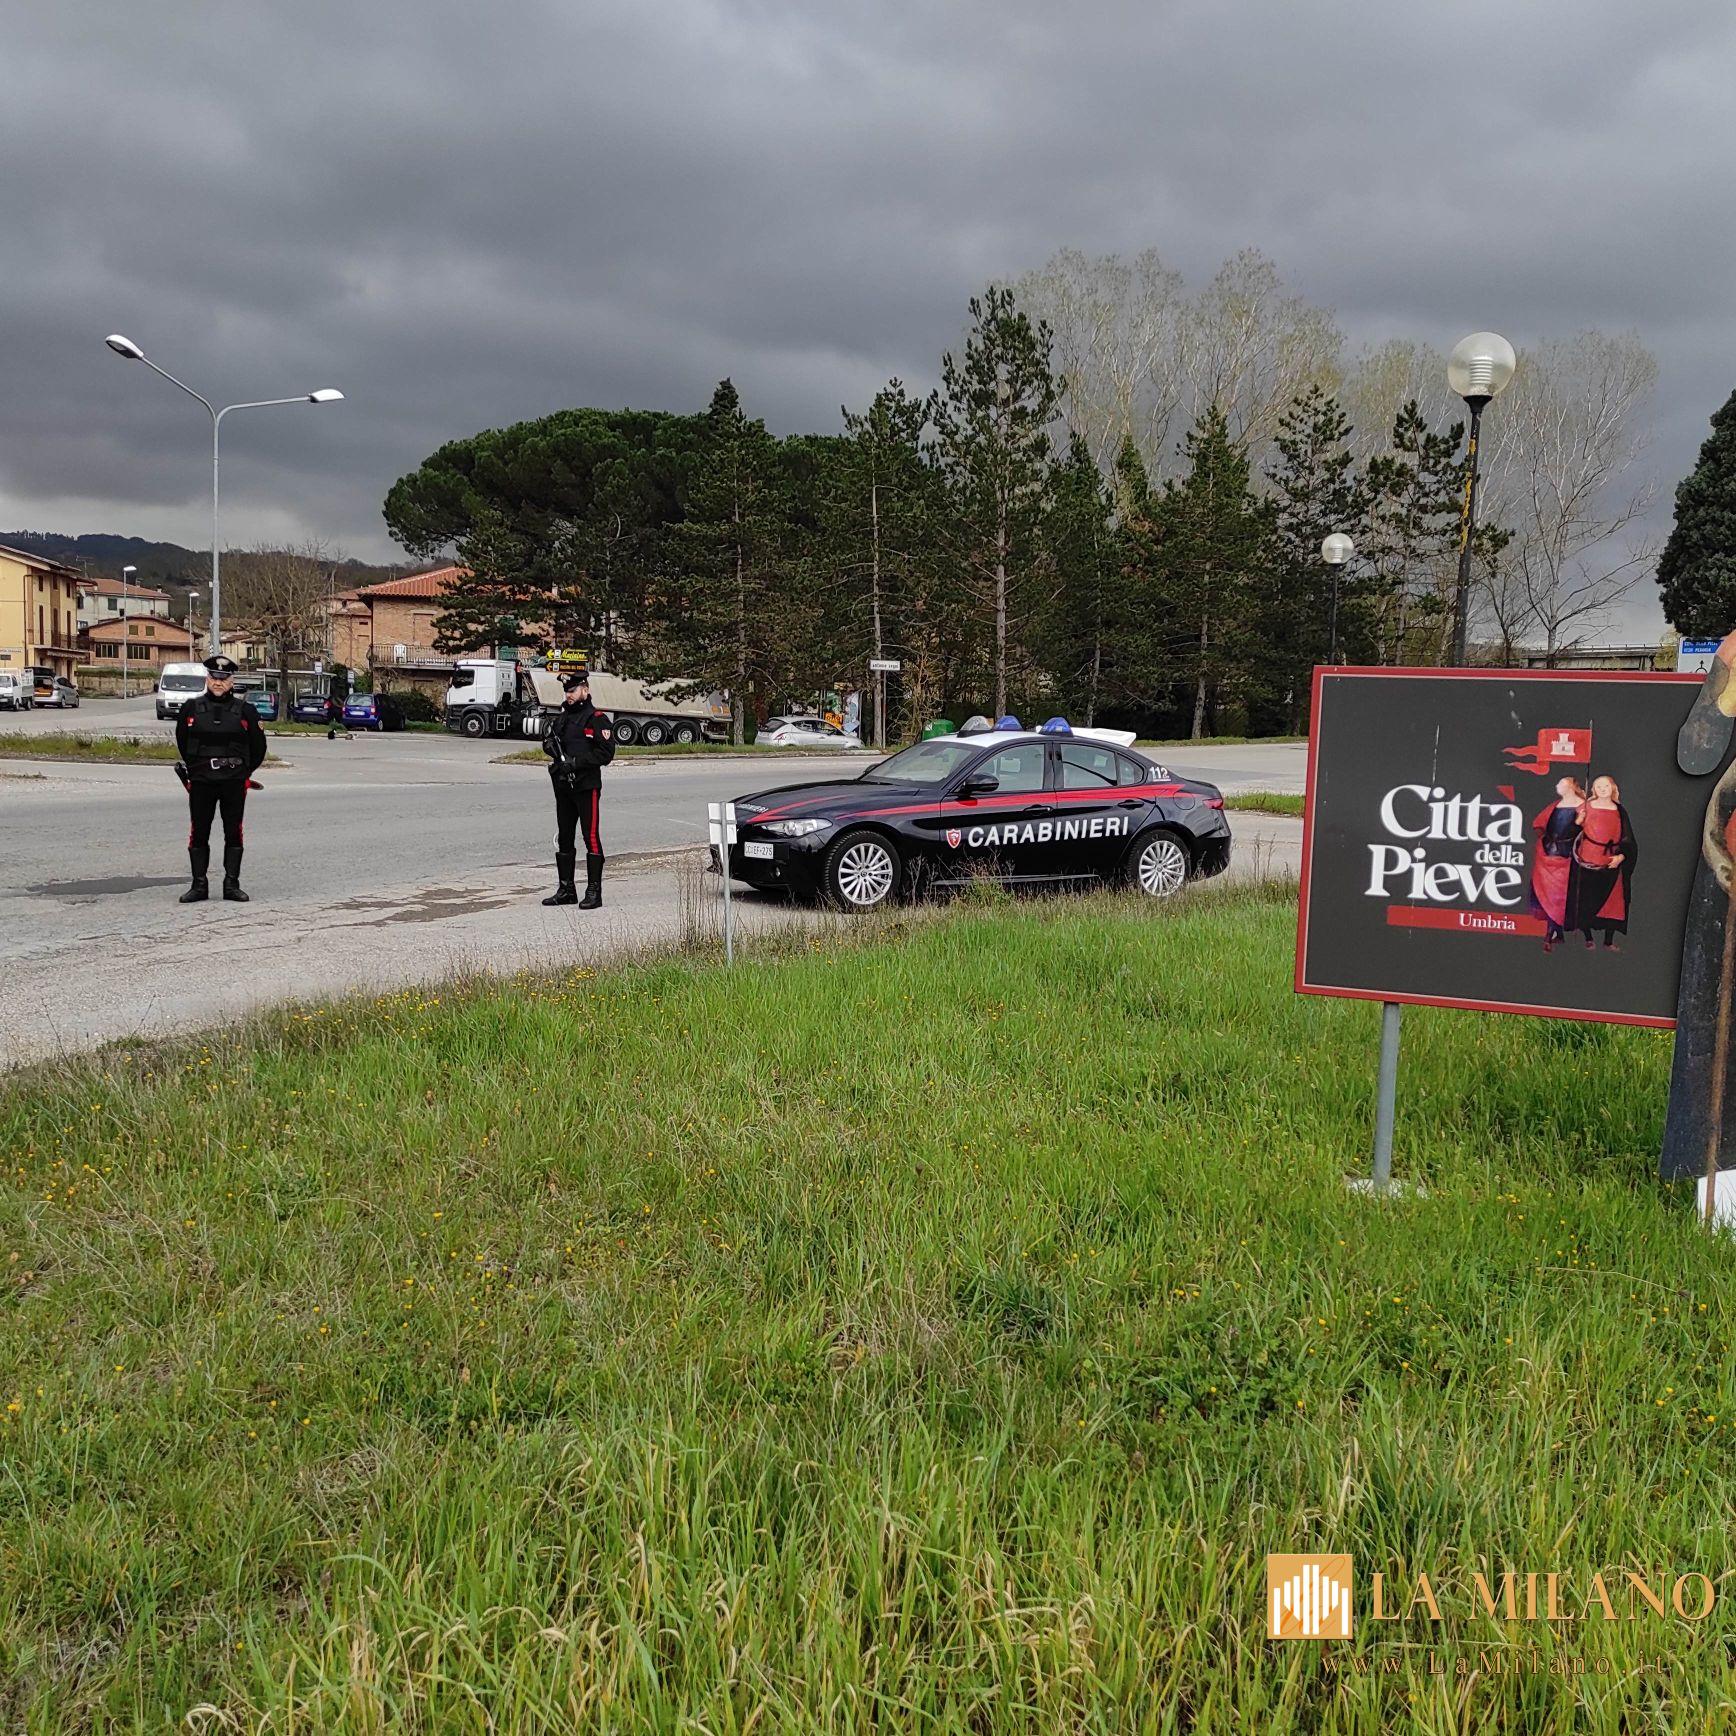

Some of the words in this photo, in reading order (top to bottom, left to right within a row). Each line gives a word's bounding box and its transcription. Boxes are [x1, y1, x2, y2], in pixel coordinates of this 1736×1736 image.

[1149, 766, 1170, 779] 112
[1381, 784, 1526, 844] Città
[968, 816, 1129, 847] CARABINIERI
[1475, 844, 1525, 866] della
[1364, 844, 1522, 906] Pieve
[1459, 912, 1516, 931] Umbria
